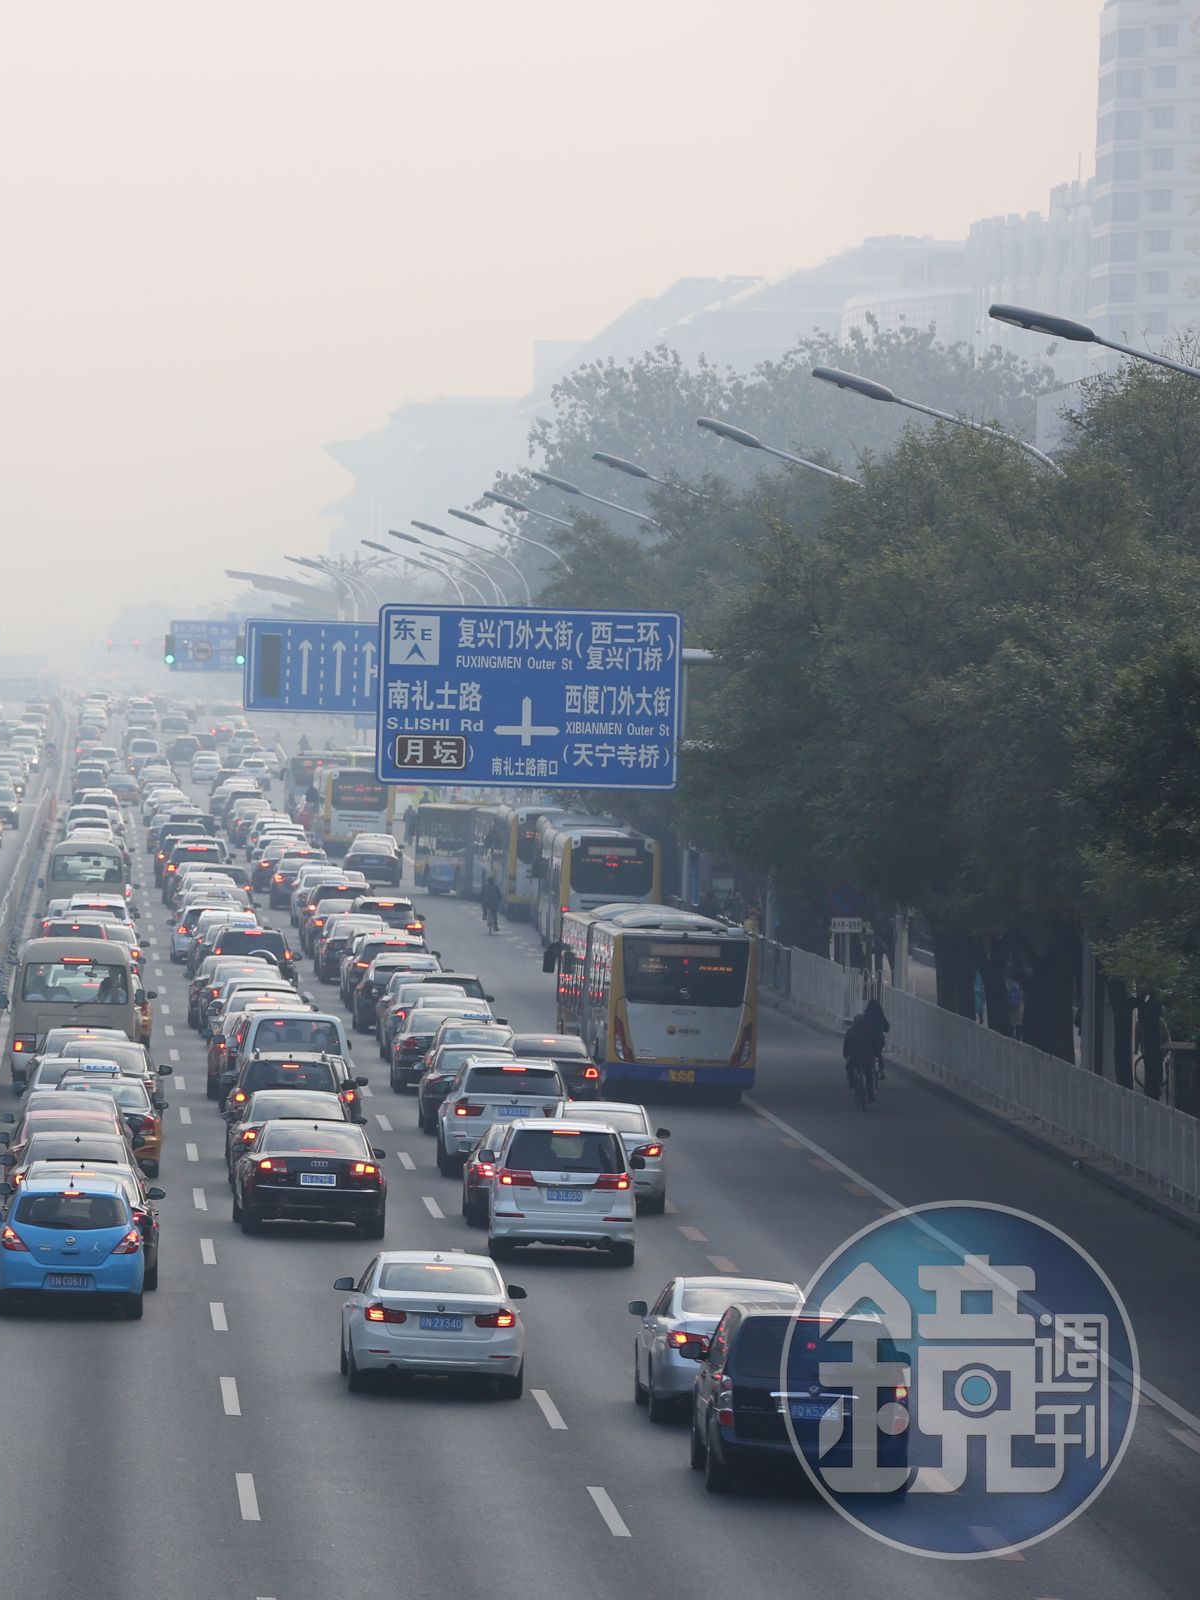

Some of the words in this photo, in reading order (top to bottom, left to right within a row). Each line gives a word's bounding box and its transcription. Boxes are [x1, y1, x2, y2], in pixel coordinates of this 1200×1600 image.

[393, 617, 416, 641] 东
[420, 628, 433, 641] E
[458, 617, 574, 651] 复兴门外大街
[590, 621, 660, 645] 西二环
[456, 655, 522, 669] FUXINGMEN
[527, 657, 557, 670] Outer
[561, 657, 573, 671] St
[586, 646, 663, 671] 复兴门桥
[387, 680, 483, 712] 南礼士路
[565, 684, 671, 717] 西便门外大街
[386, 717, 450, 731] S.LISHI
[460, 718, 484, 732] Rd
[565, 721, 623, 735] XIBIANMEN
[626, 723, 654, 737] Outer
[658, 724, 670, 737] St
[491, 757, 558, 777] 南礼士路南口
